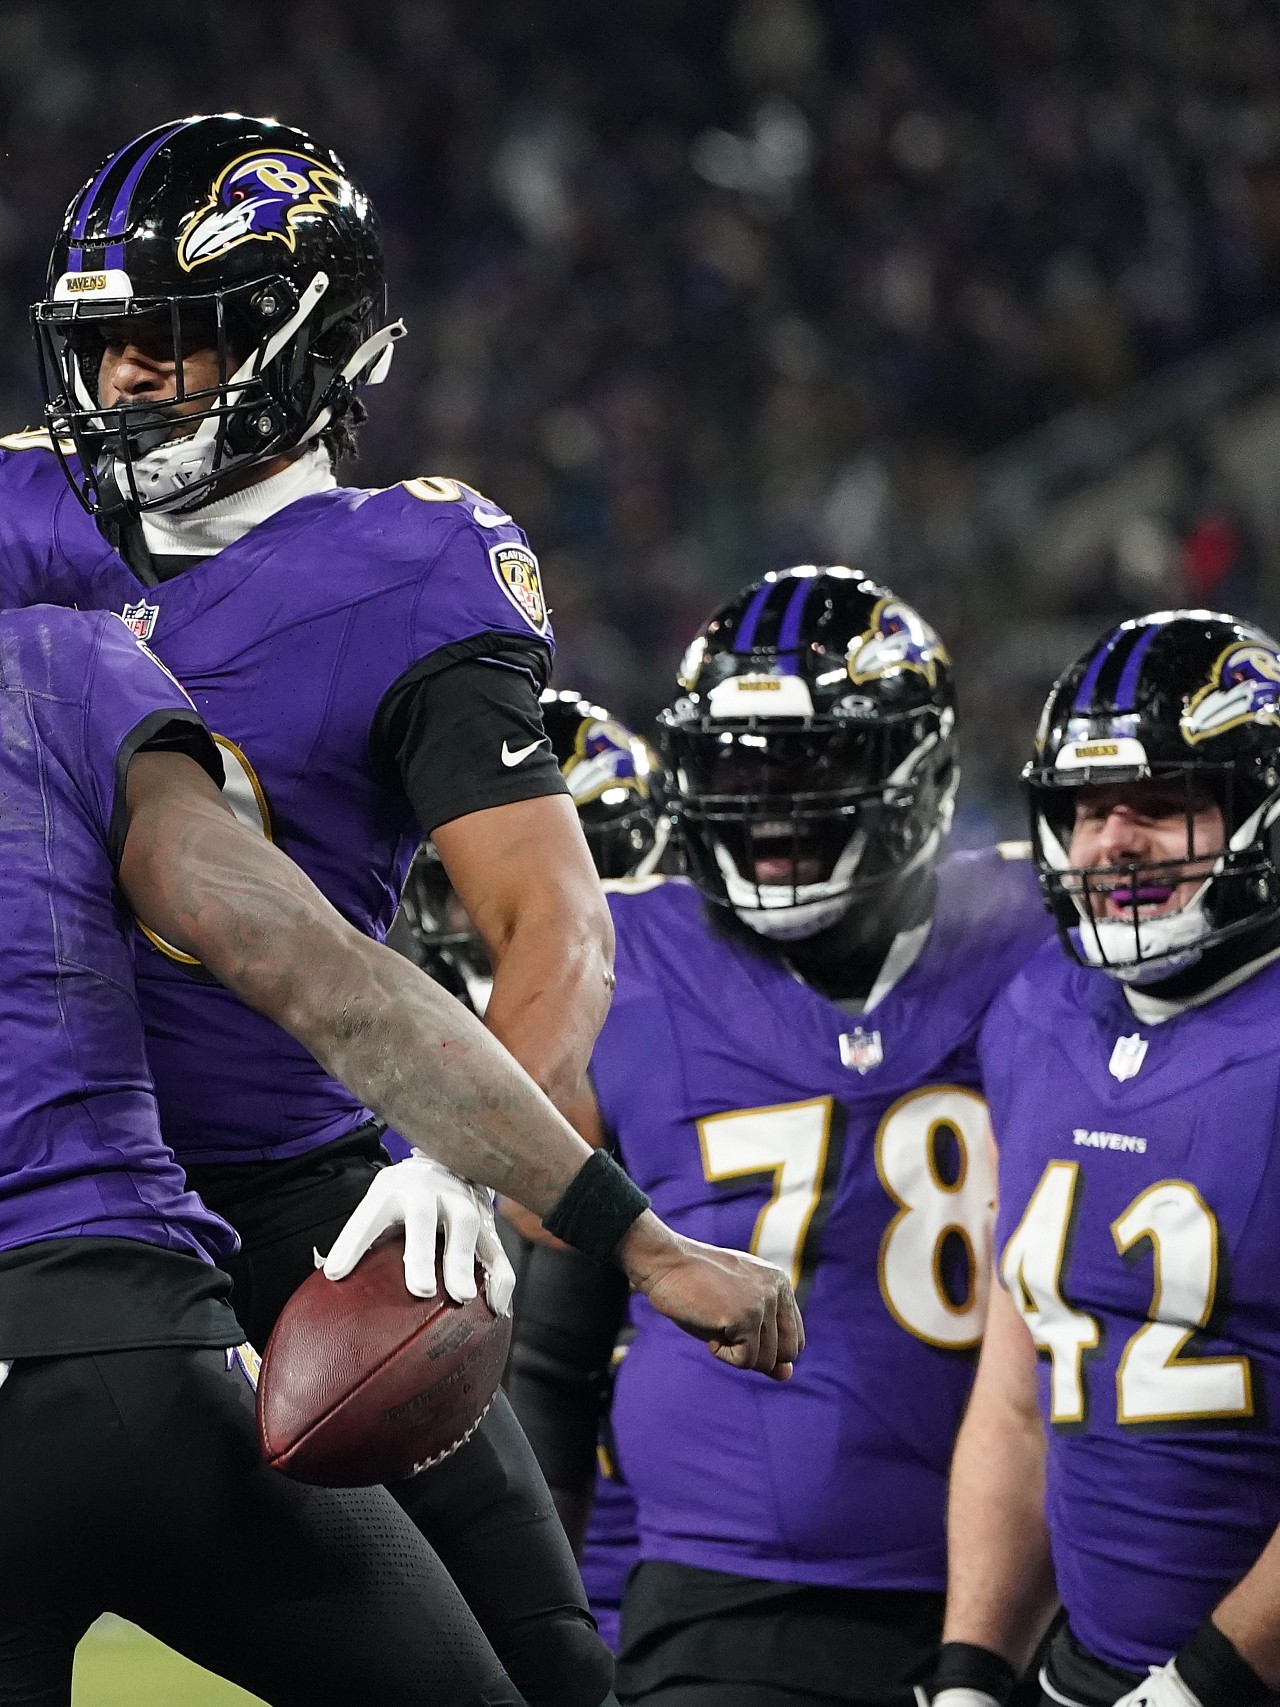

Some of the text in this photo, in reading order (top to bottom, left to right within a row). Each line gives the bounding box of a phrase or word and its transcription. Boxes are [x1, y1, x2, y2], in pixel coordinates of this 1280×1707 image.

[66, 275, 107, 292] RAVENS
[1072, 1128, 1148, 1154] RAVENS
[696, 1084, 996, 1351] 78
[1000, 1159, 1254, 1425] 42
